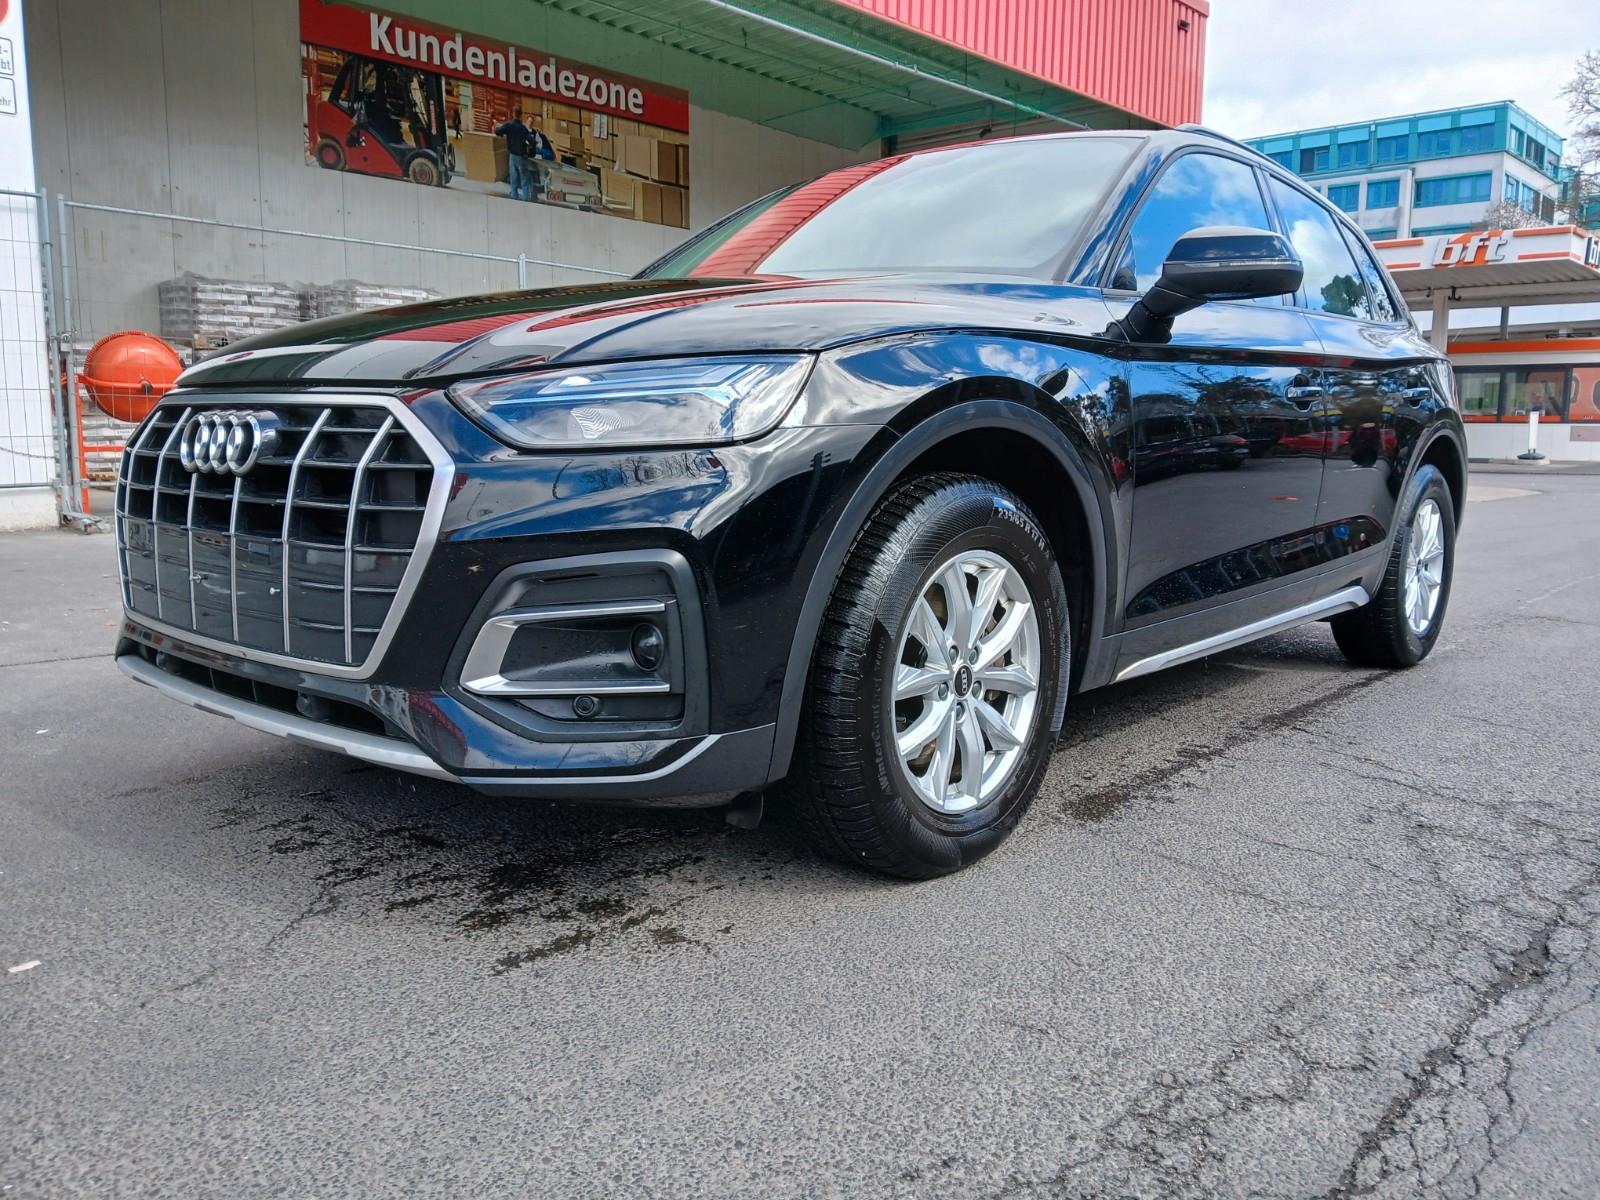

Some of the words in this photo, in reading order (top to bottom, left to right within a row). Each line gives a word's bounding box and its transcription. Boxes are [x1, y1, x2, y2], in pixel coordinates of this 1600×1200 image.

[370, 12, 644, 114] Kundenladezone
[1432, 232, 1508, 265] bft
[998, 508, 1024, 528] 235/65
